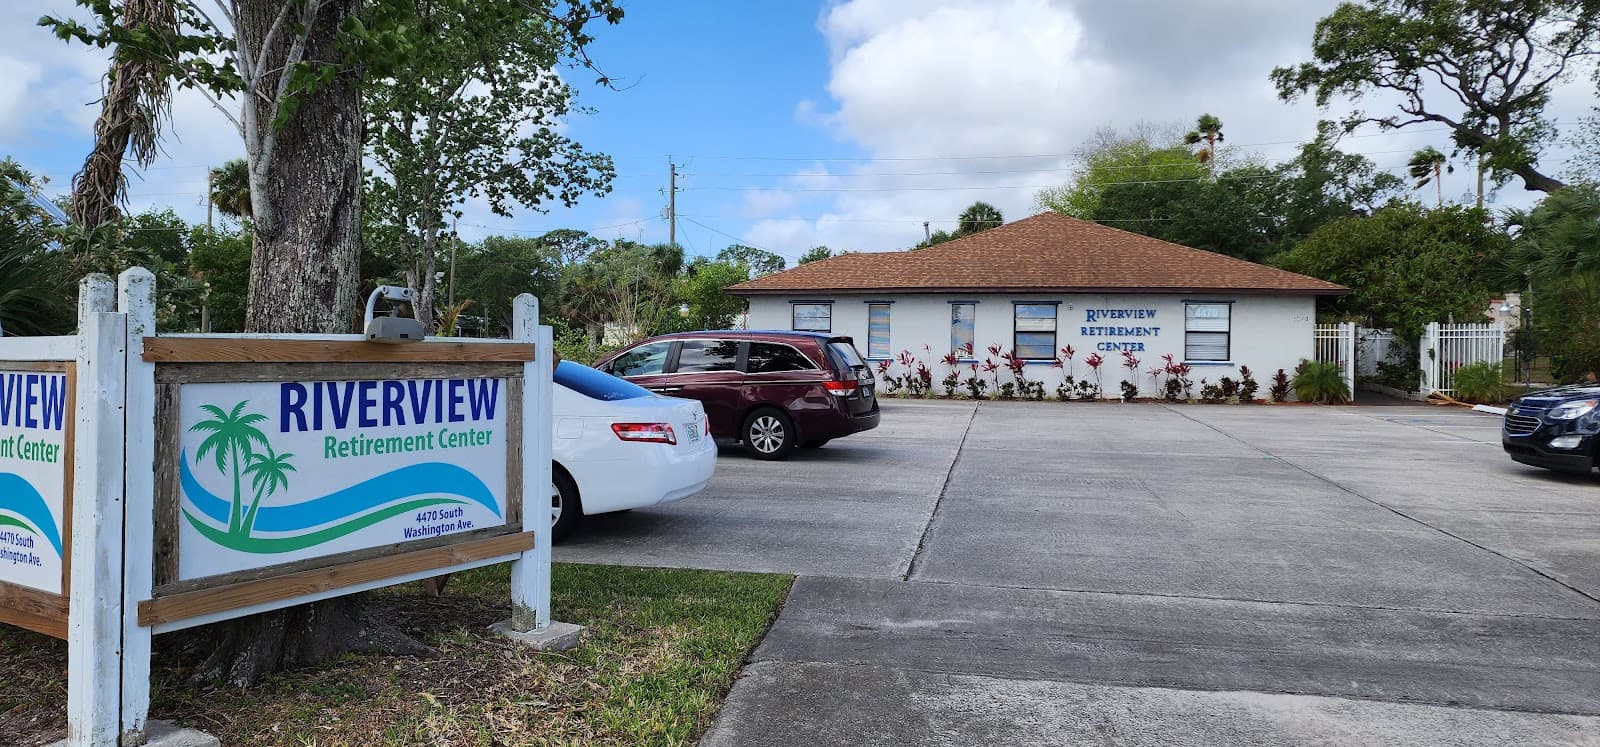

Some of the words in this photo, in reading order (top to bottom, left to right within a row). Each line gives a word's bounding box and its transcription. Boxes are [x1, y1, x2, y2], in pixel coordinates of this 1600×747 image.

[1085, 309, 1157, 322] RIVERVIEW
[1080, 326, 1161, 337] RETIREMENT
[1097, 342, 1145, 352] CENTER
[280, 378, 499, 432] RIVERVIEW
[17, 434, 60, 463] Center
[324, 431, 434, 459] Retirement
[438, 428, 493, 449] Center
[416, 510, 438, 523] 4470
[439, 506, 464, 520] South
[404, 522, 455, 539] Washington
[457, 519, 474, 530] Ave.
[15, 533, 34, 549] South
[29, 552, 42, 567] Ave.
